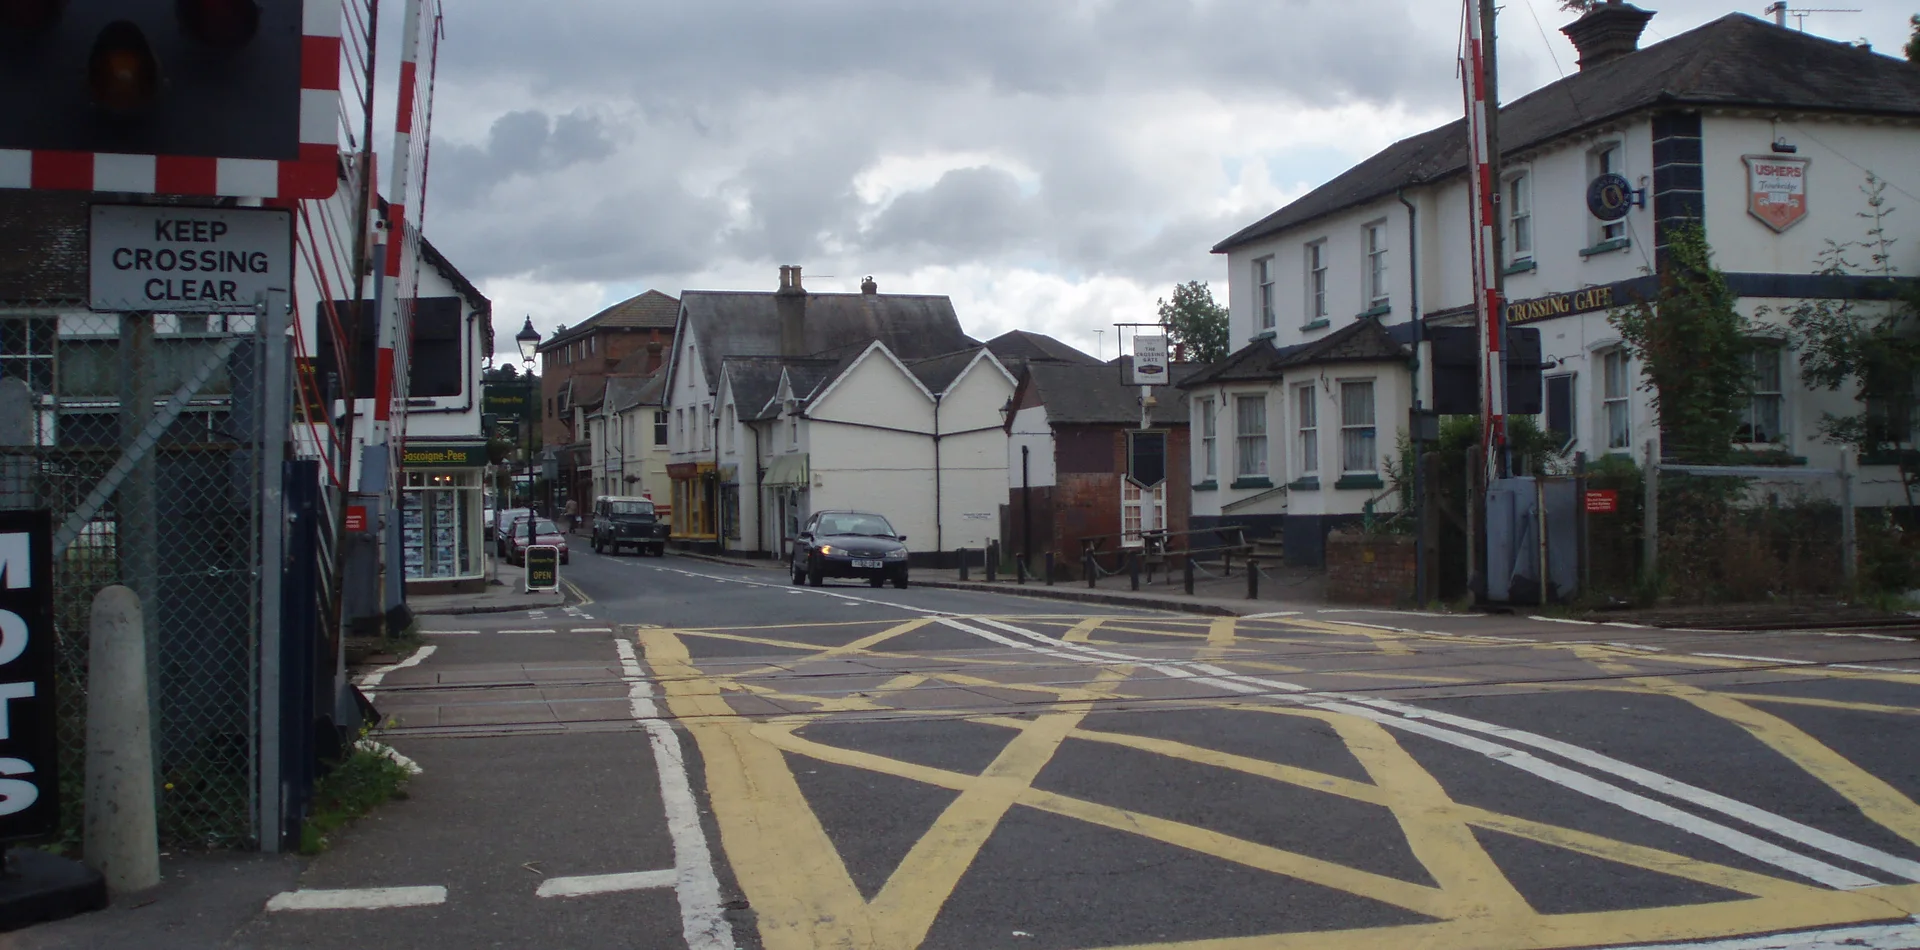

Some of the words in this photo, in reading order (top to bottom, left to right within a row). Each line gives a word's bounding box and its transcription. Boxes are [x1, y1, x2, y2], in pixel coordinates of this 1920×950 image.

[1754, 164, 1802, 178] USHERS
[155, 219, 228, 242] KEEP
[112, 247, 269, 273] CROSSING
[144, 278, 237, 301] CLEAR
[1506, 294, 1570, 322] CROSSING
[533, 571, 552, 580] OPEN
